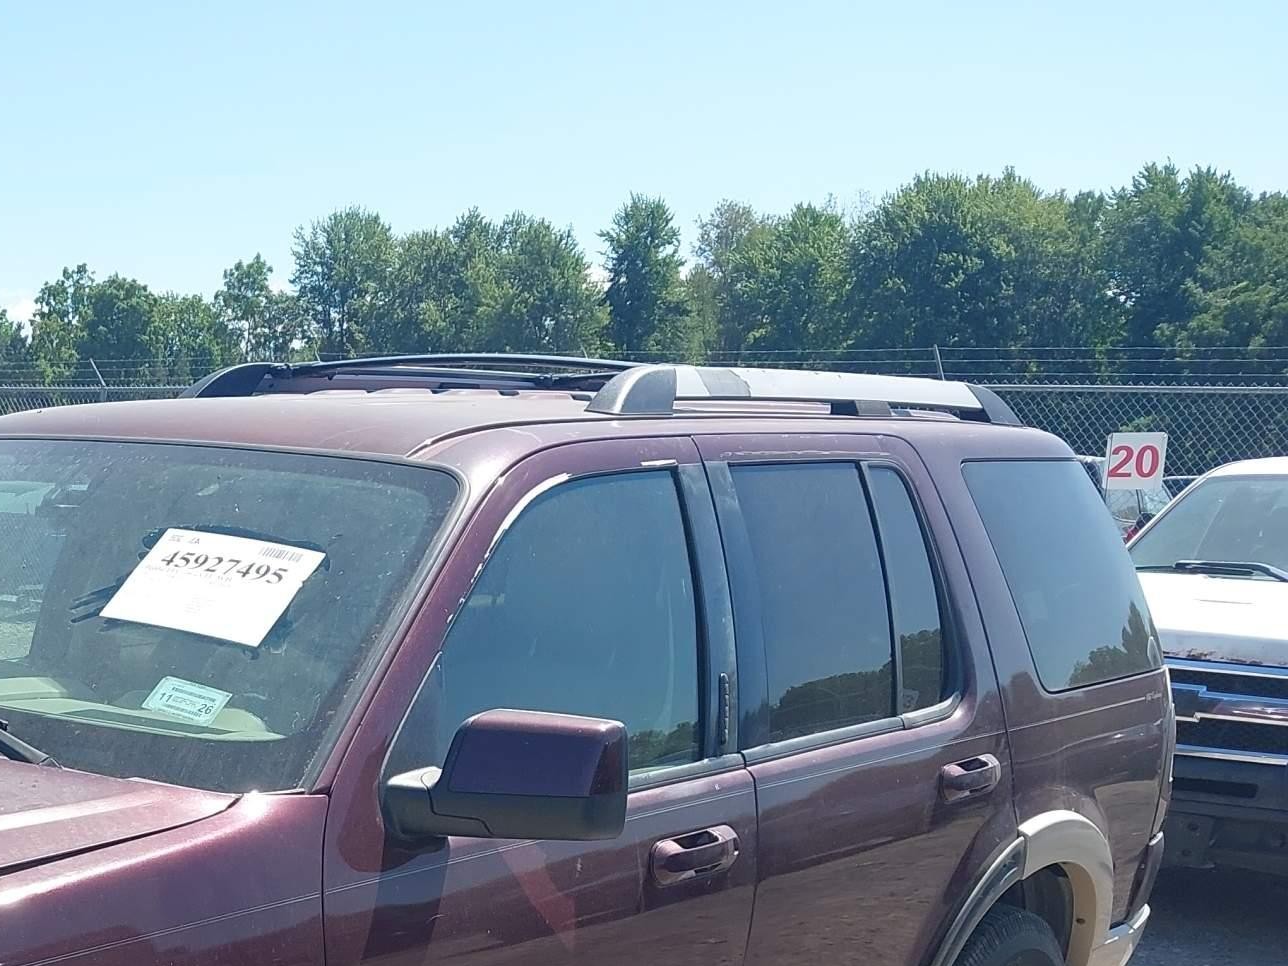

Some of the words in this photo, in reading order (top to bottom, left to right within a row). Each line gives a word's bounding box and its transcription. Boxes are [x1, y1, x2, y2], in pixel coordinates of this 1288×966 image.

[1107, 444, 1160, 479] 20
[160, 549, 289, 586] 45927495
[158, 691, 174, 704] 11
[197, 702, 214, 716] 26
